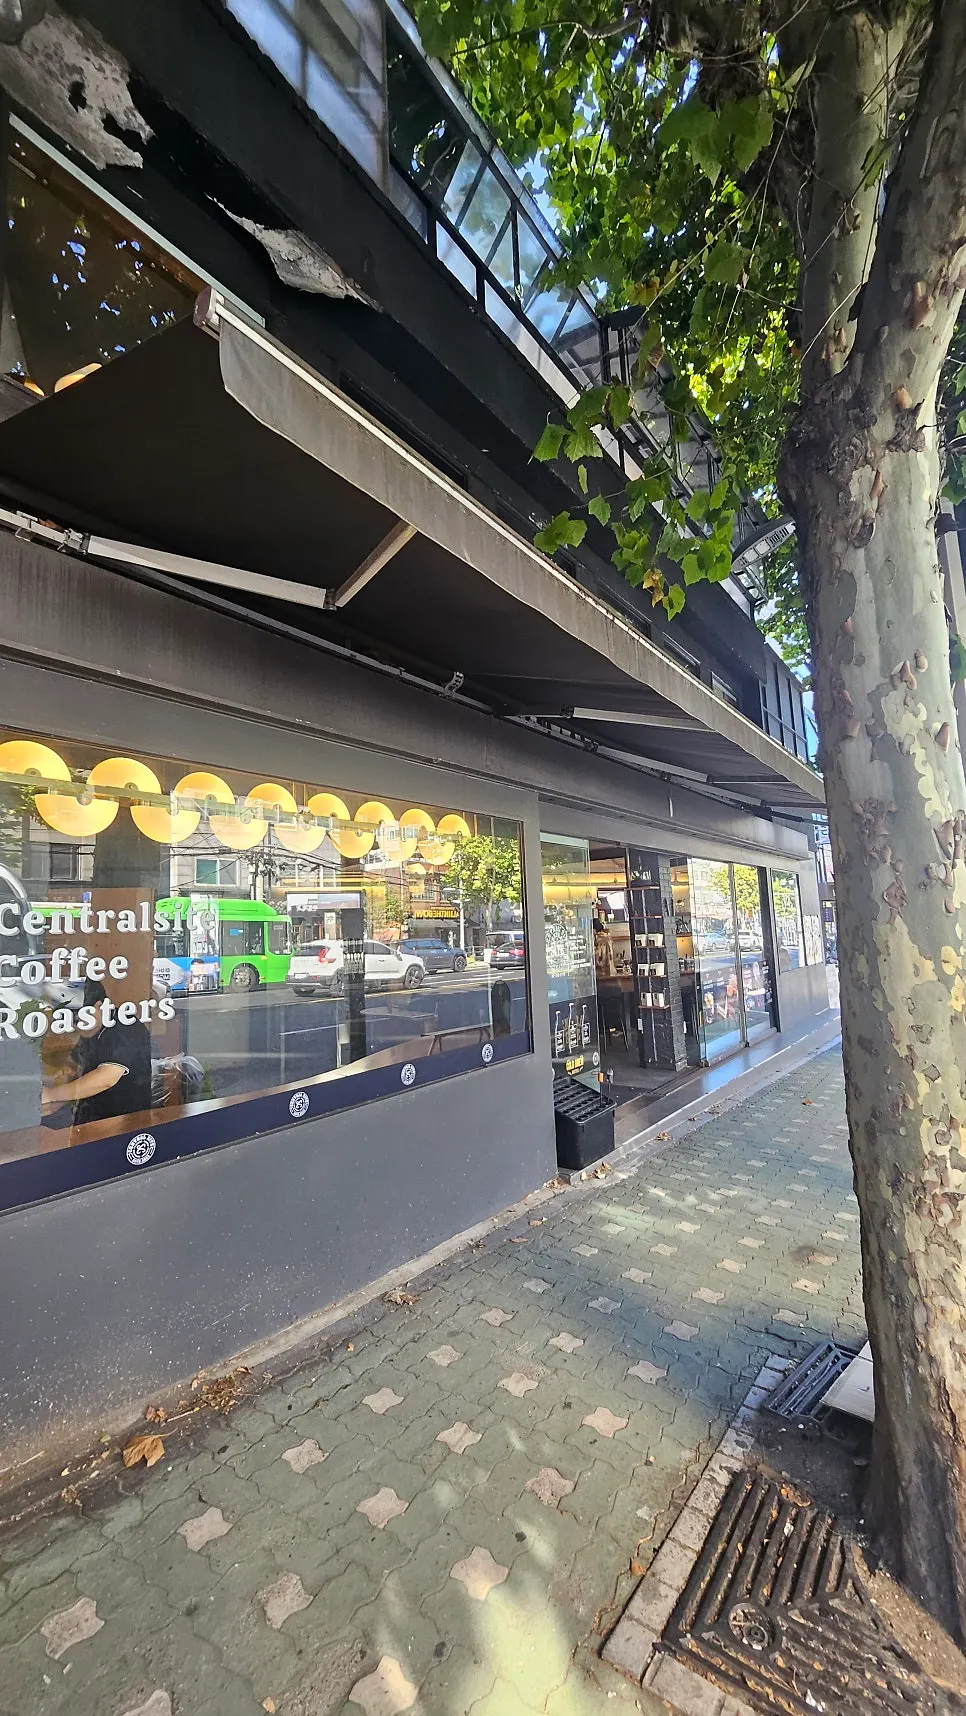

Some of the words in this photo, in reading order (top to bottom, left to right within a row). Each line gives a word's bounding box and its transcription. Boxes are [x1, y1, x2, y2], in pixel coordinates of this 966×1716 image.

[0, 903, 216, 936] Centralsite
[0, 946, 129, 987] Coffee
[0, 997, 176, 1040] Roasters
